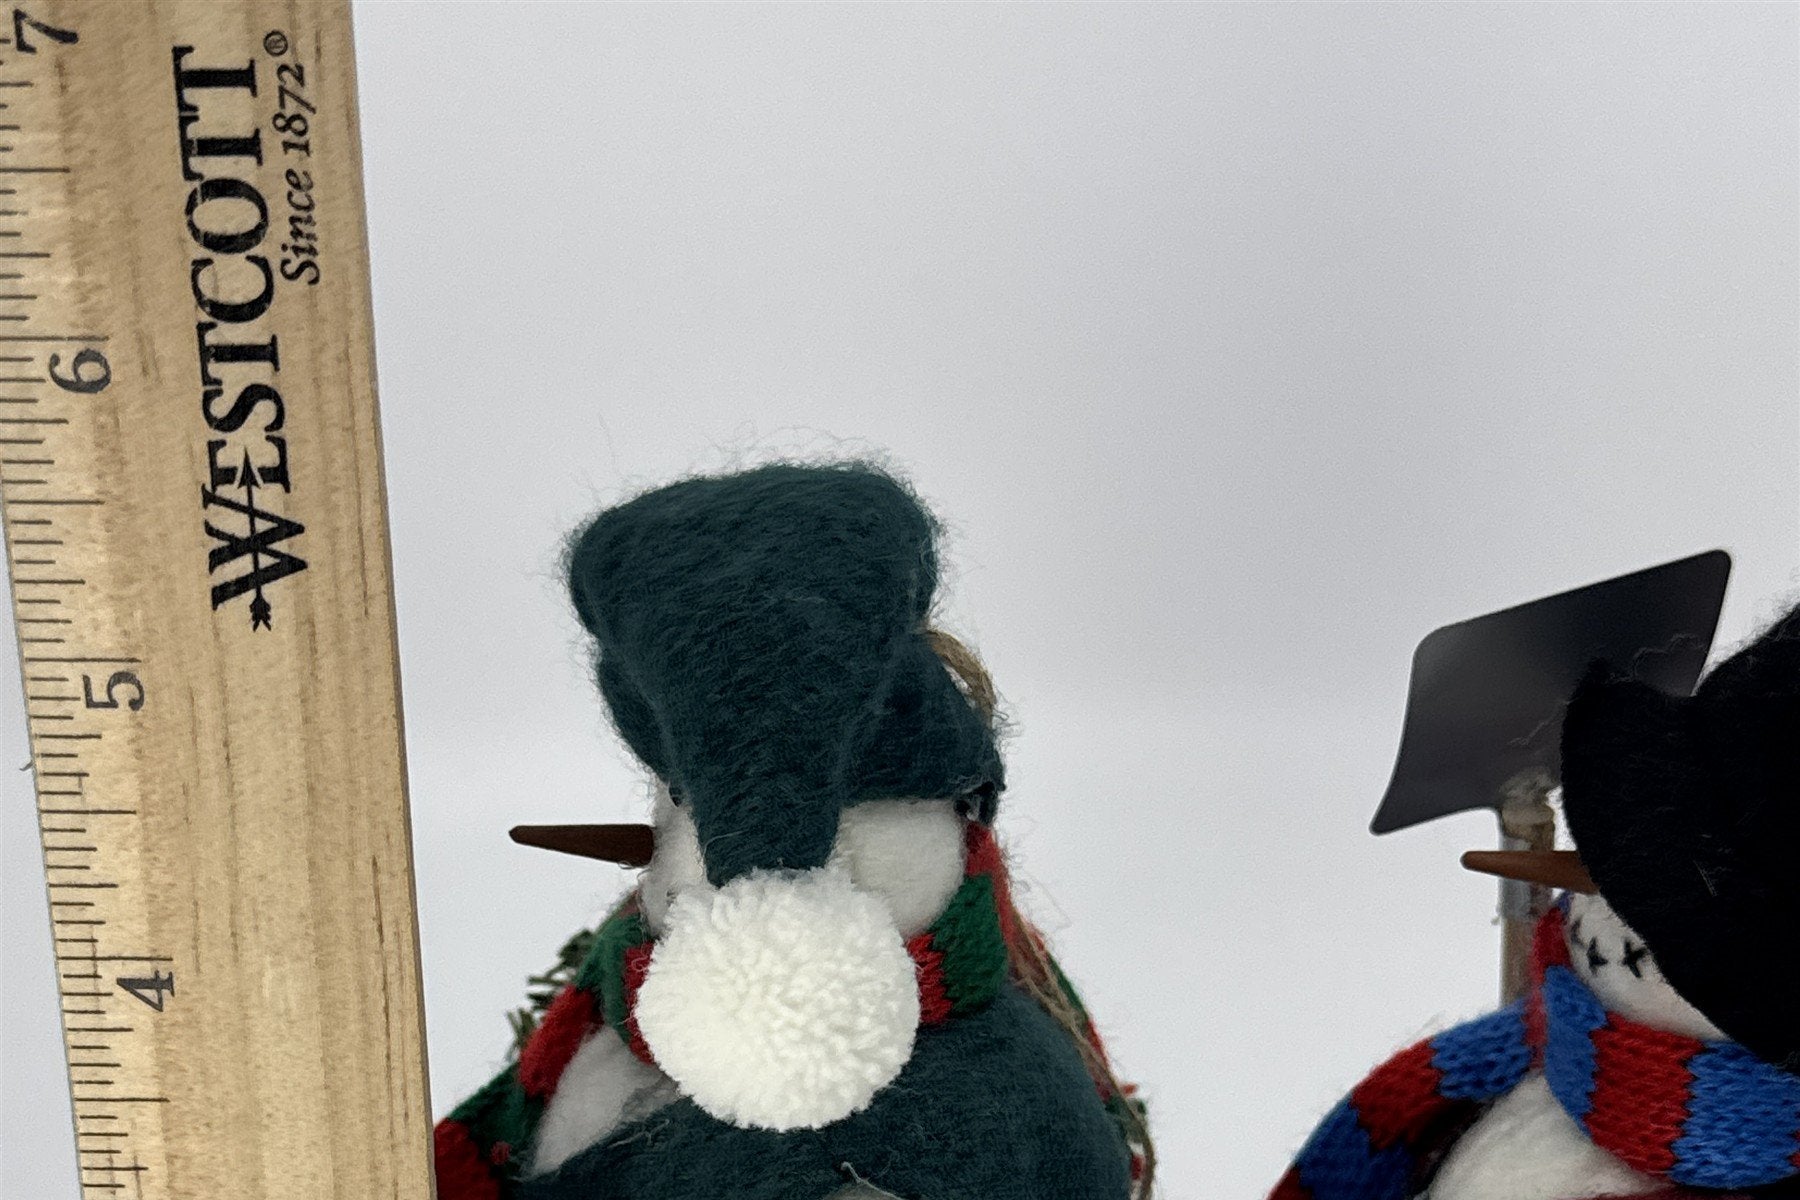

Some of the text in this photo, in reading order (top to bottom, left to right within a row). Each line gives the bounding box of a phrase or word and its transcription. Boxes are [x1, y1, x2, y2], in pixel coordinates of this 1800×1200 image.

[13, 8, 80, 55] 7
[280, 168, 321, 286] Since
[171, 45, 309, 611] WESTCOTT
[48, 347, 112, 395] 6
[81, 669, 146, 712] 5
[115, 969, 176, 1013] 4
